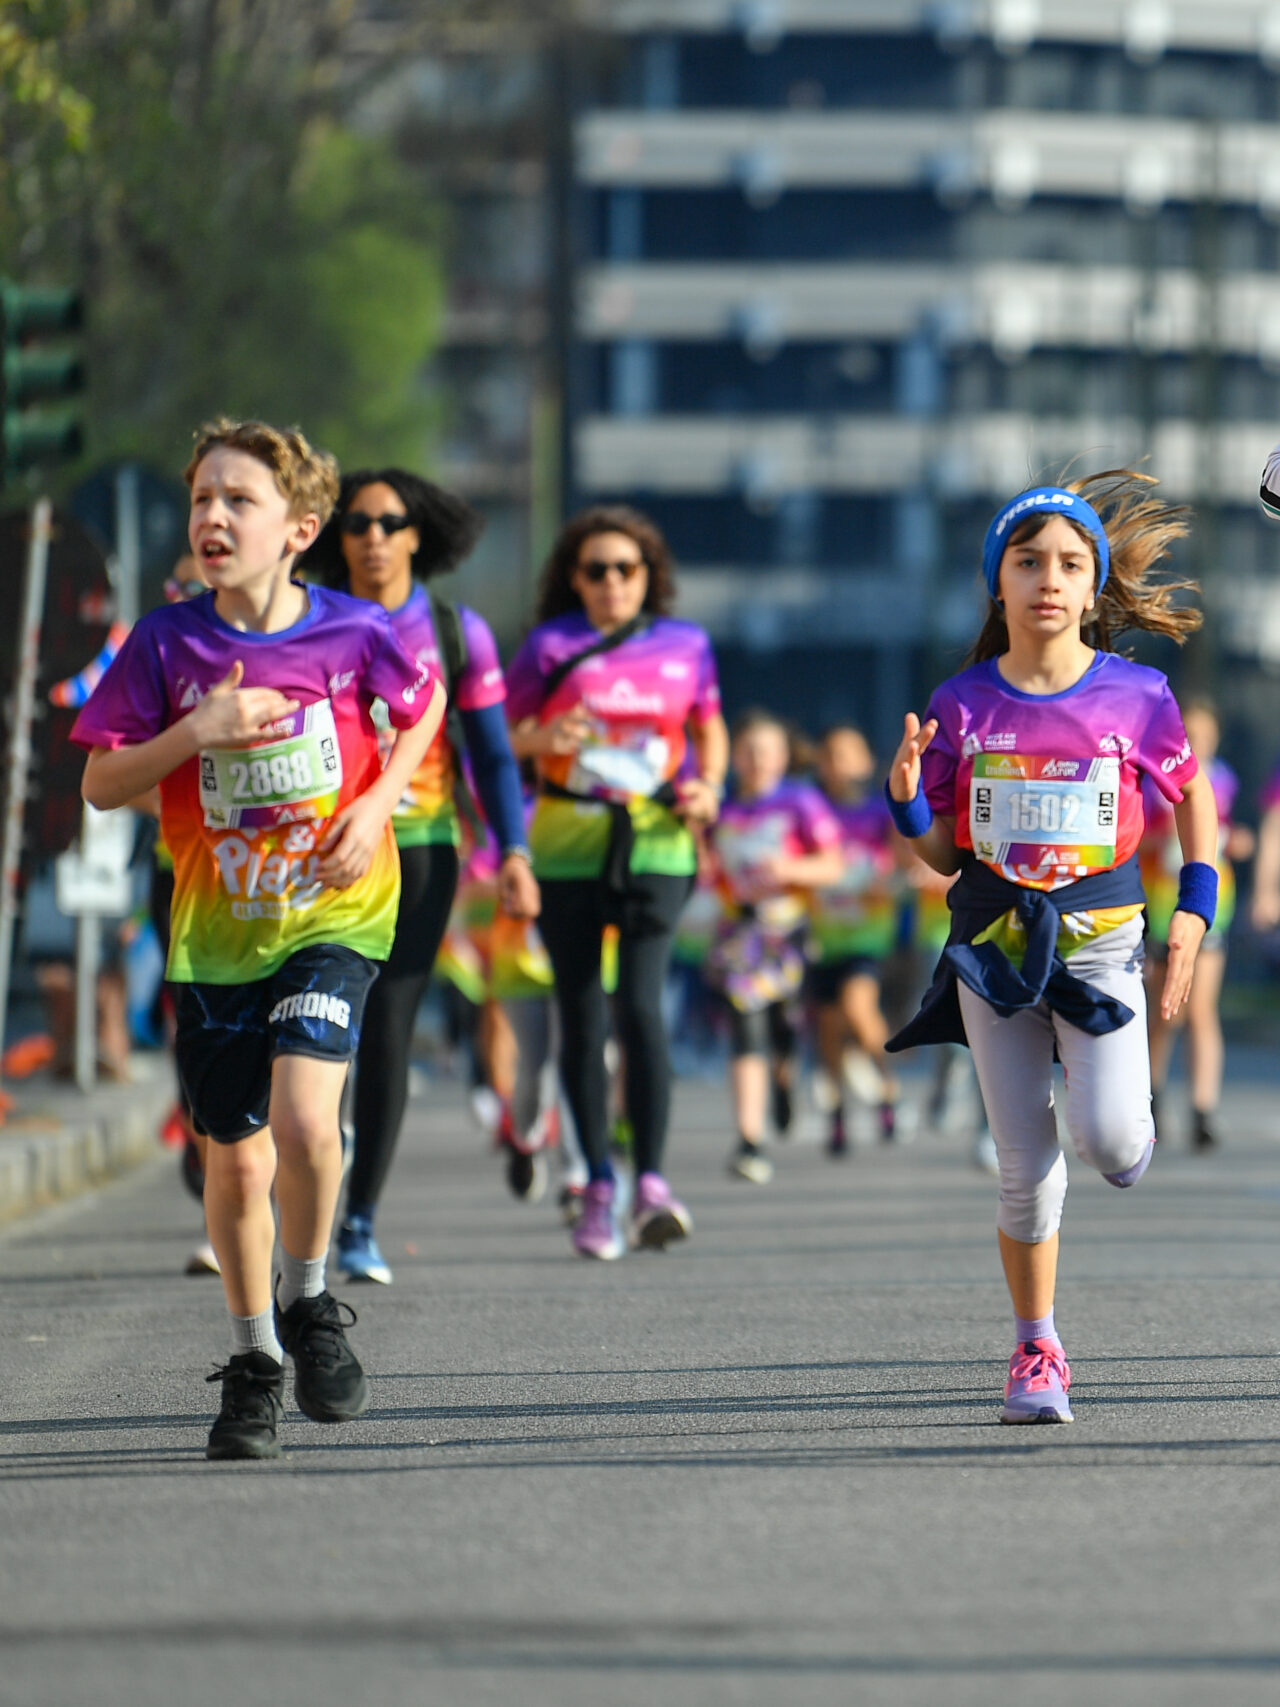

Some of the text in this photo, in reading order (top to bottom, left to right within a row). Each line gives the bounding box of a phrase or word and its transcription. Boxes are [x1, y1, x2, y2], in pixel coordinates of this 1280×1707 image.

[229, 750, 312, 799] 2888
[1007, 791, 1081, 834] 1502
[284, 824, 315, 852] &
[213, 836, 323, 910] Play
[268, 990, 350, 1030] STRONG
